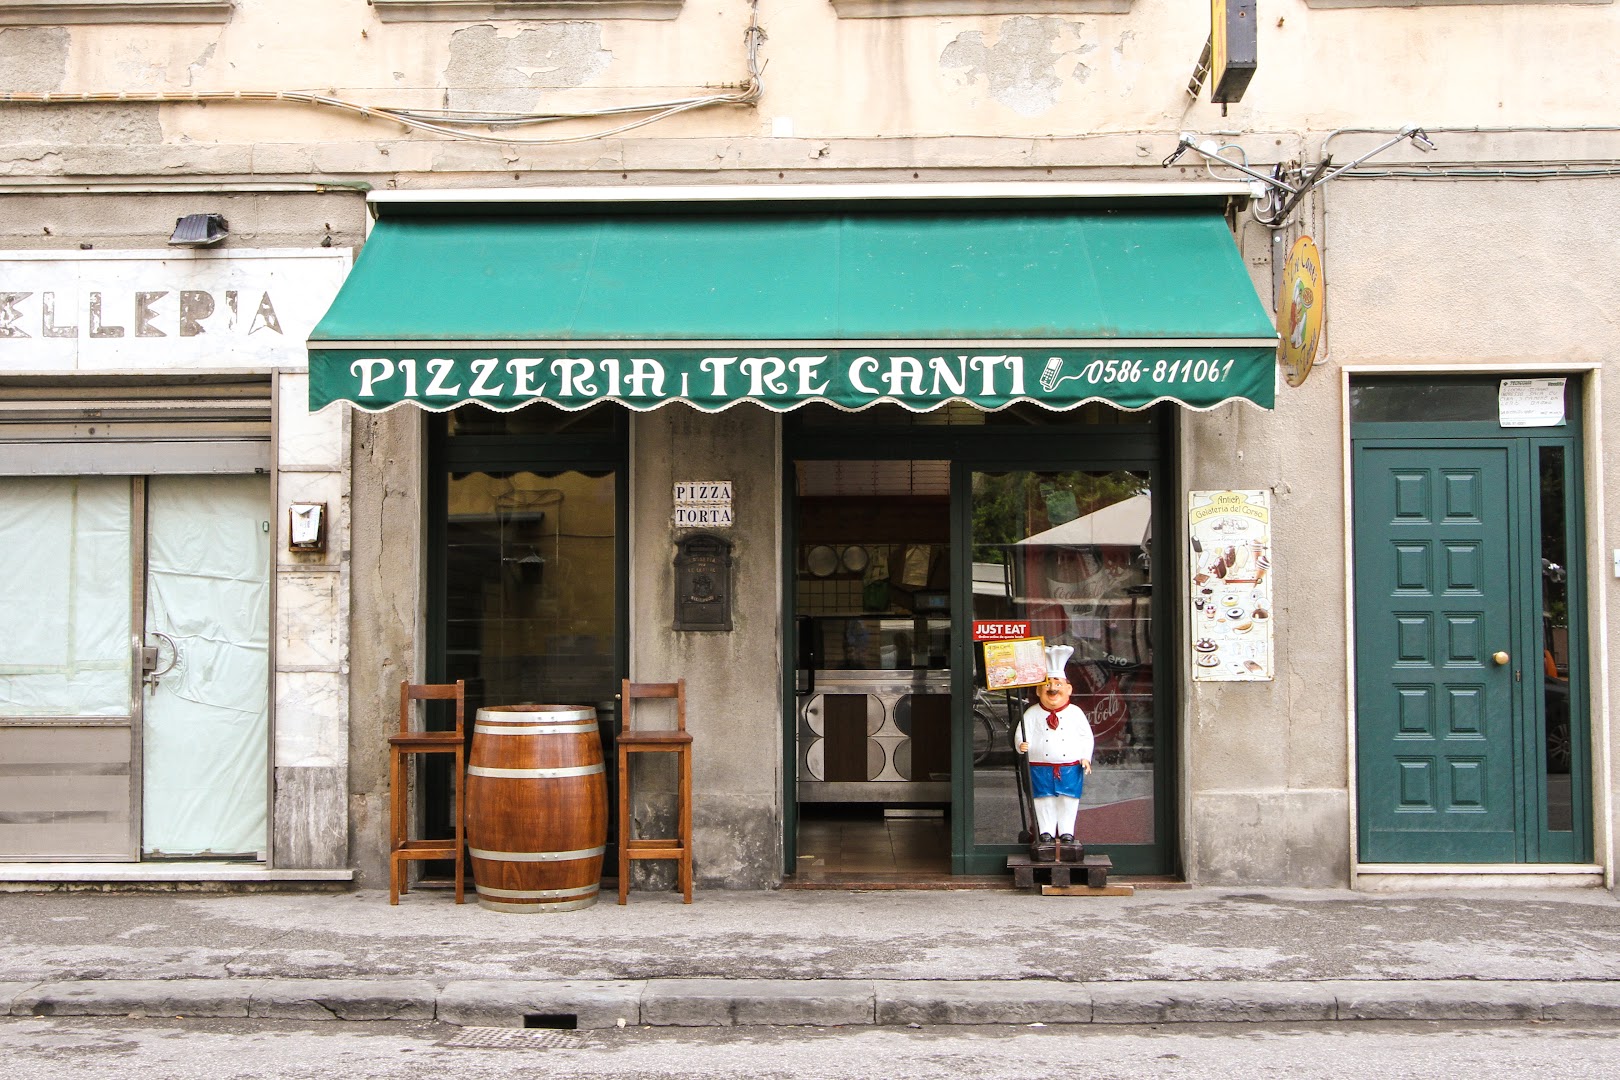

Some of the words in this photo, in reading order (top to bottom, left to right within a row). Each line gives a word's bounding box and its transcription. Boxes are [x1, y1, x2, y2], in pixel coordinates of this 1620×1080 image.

[350, 357, 667, 397] PIZZERIA
[699, 356, 830, 398] TRE
[848, 355, 1026, 398] CANTI
[1087, 359, 1236, 385] 0586-811061
[676, 486, 731, 499] PIZZA
[676, 508, 731, 523] TORTA
[975, 624, 1003, 635] JUST
[1004, 624, 1027, 635] EAT
